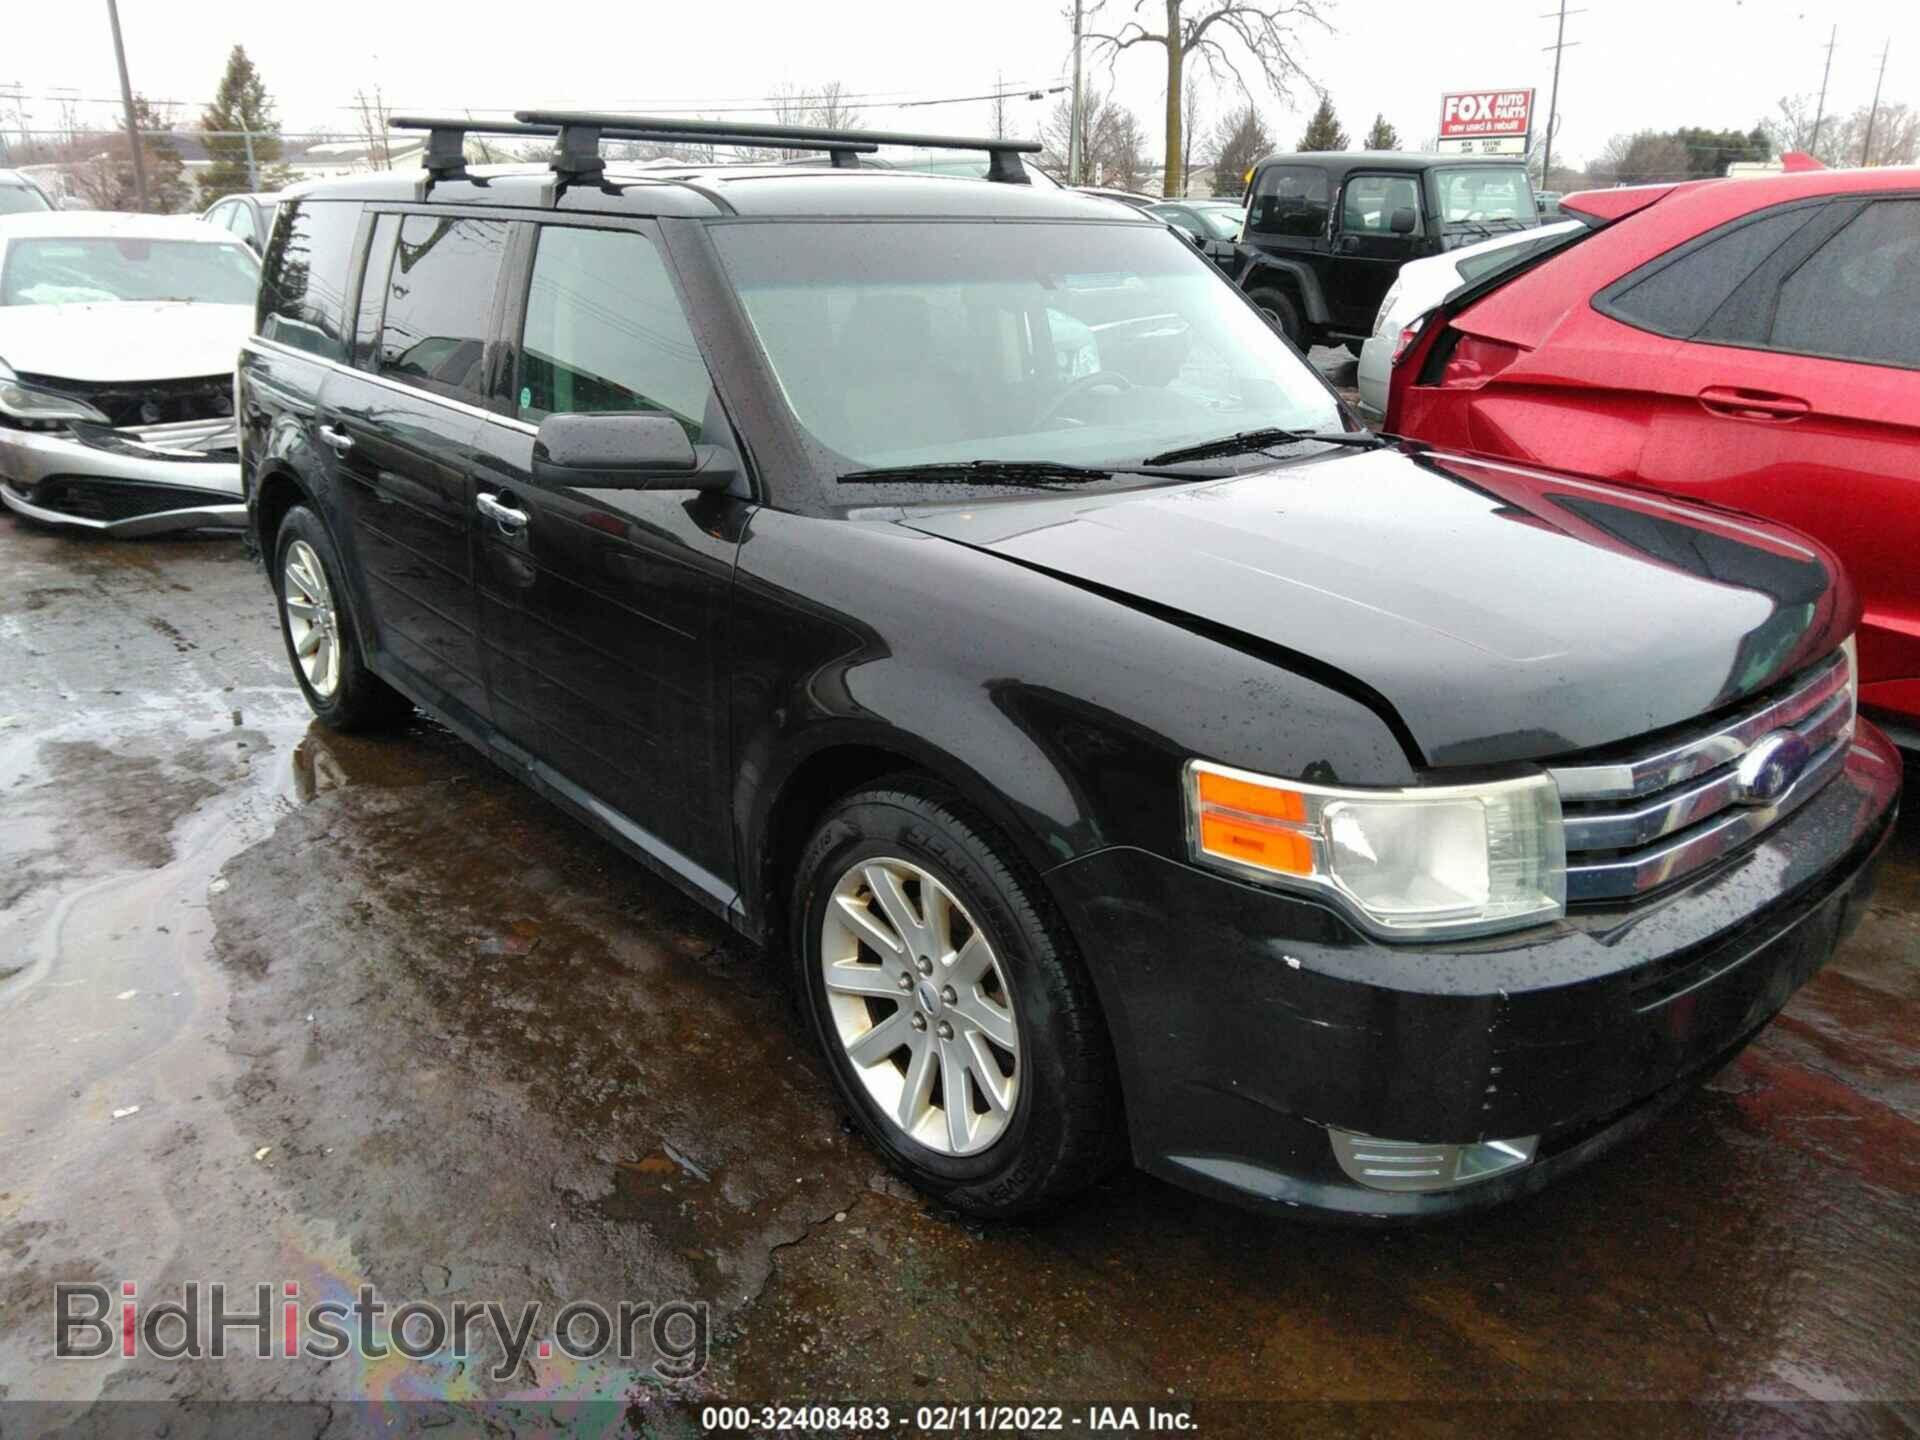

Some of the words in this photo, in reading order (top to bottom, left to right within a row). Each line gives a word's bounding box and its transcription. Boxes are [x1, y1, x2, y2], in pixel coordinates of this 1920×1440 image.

[1496, 94, 1524, 106] AUTO
[1444, 95, 1495, 121] FOX
[1495, 106, 1526, 118] PARTS
[1466, 122, 1485, 132] used
[1486, 121, 1492, 131] &
